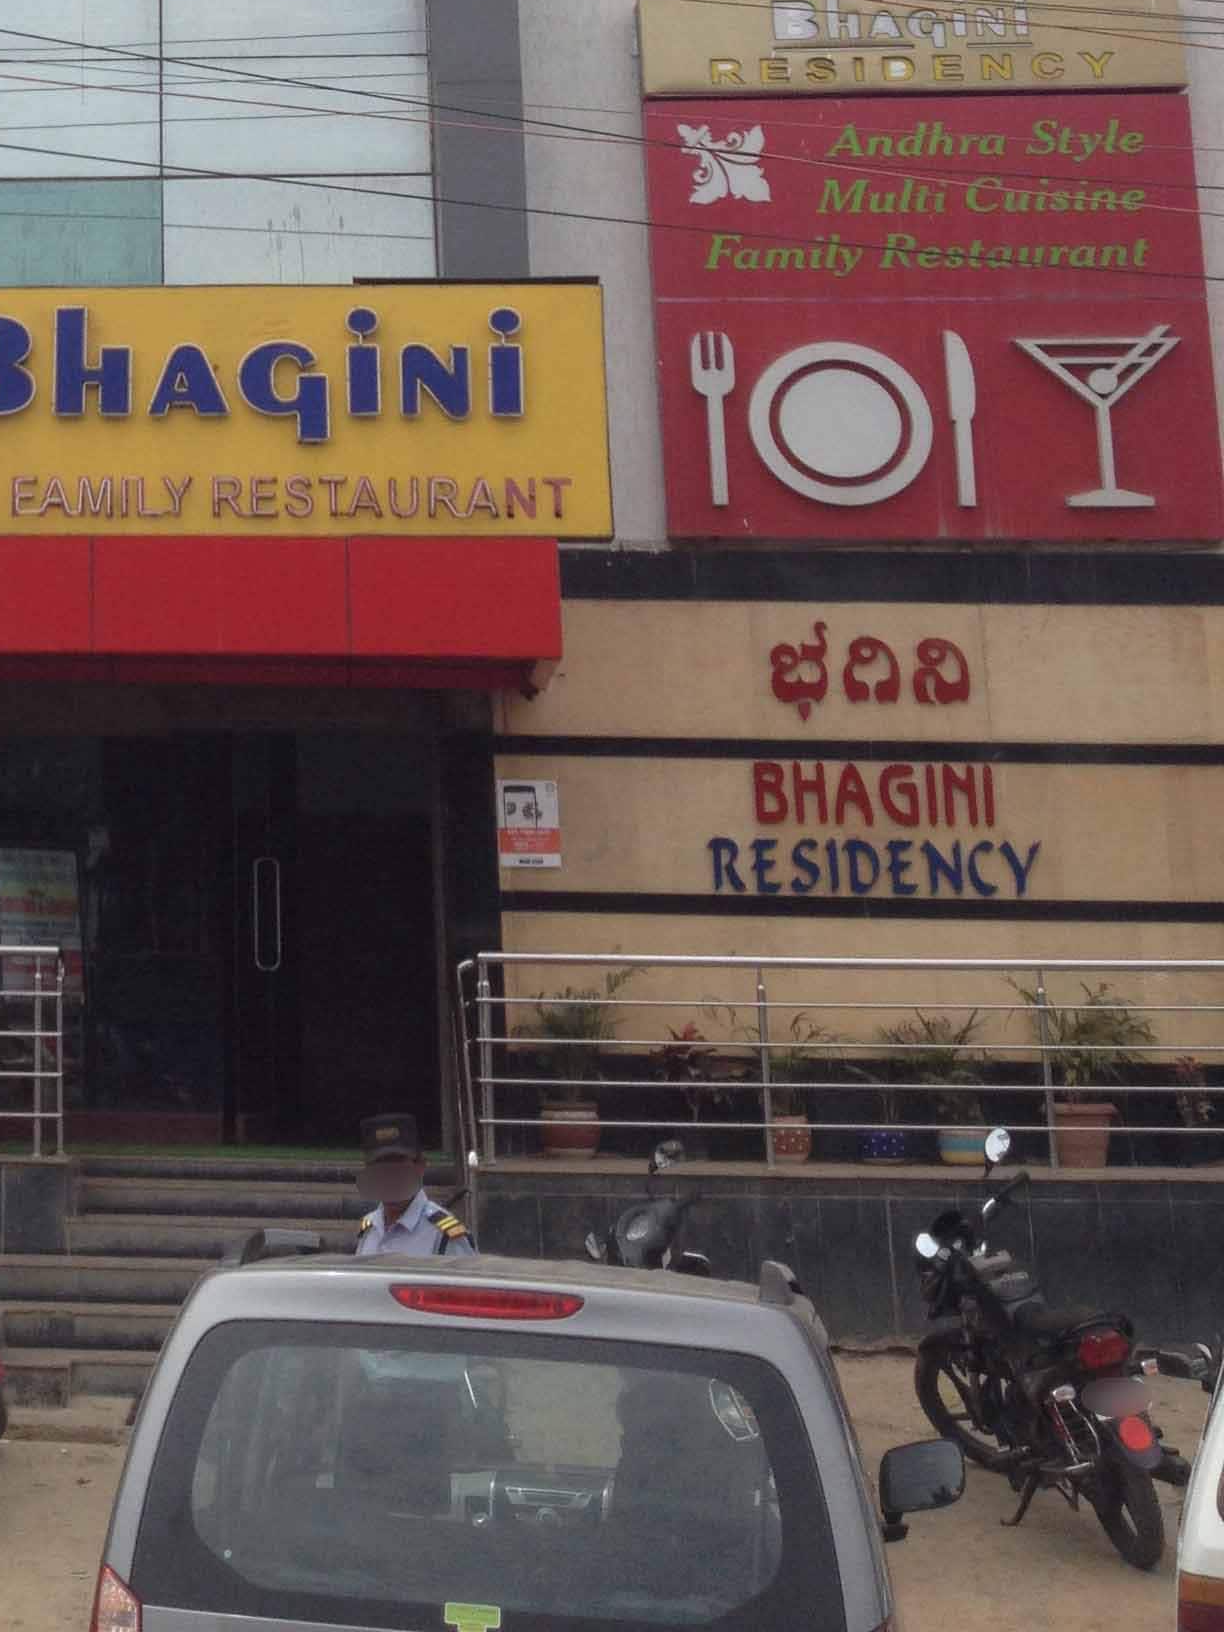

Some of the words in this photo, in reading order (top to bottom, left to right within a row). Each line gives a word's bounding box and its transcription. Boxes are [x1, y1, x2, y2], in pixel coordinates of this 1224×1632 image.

[709, 51, 1115, 85] RESIDENCY
[826, 122, 1006, 158] Andhra
[1026, 119, 1145, 161] Style
[817, 178, 947, 214] Multi
[965, 176, 1146, 214] Cuisine
[704, 233, 863, 277] Family
[880, 232, 1150, 269] Restaurant
[212, 476, 572, 521] RESTAURANT
[770, 621, 970, 722] ಭಗಿನಿ
[753, 761, 995, 827] BHAGINI
[707, 836, 1042, 897] RESIDENCY
